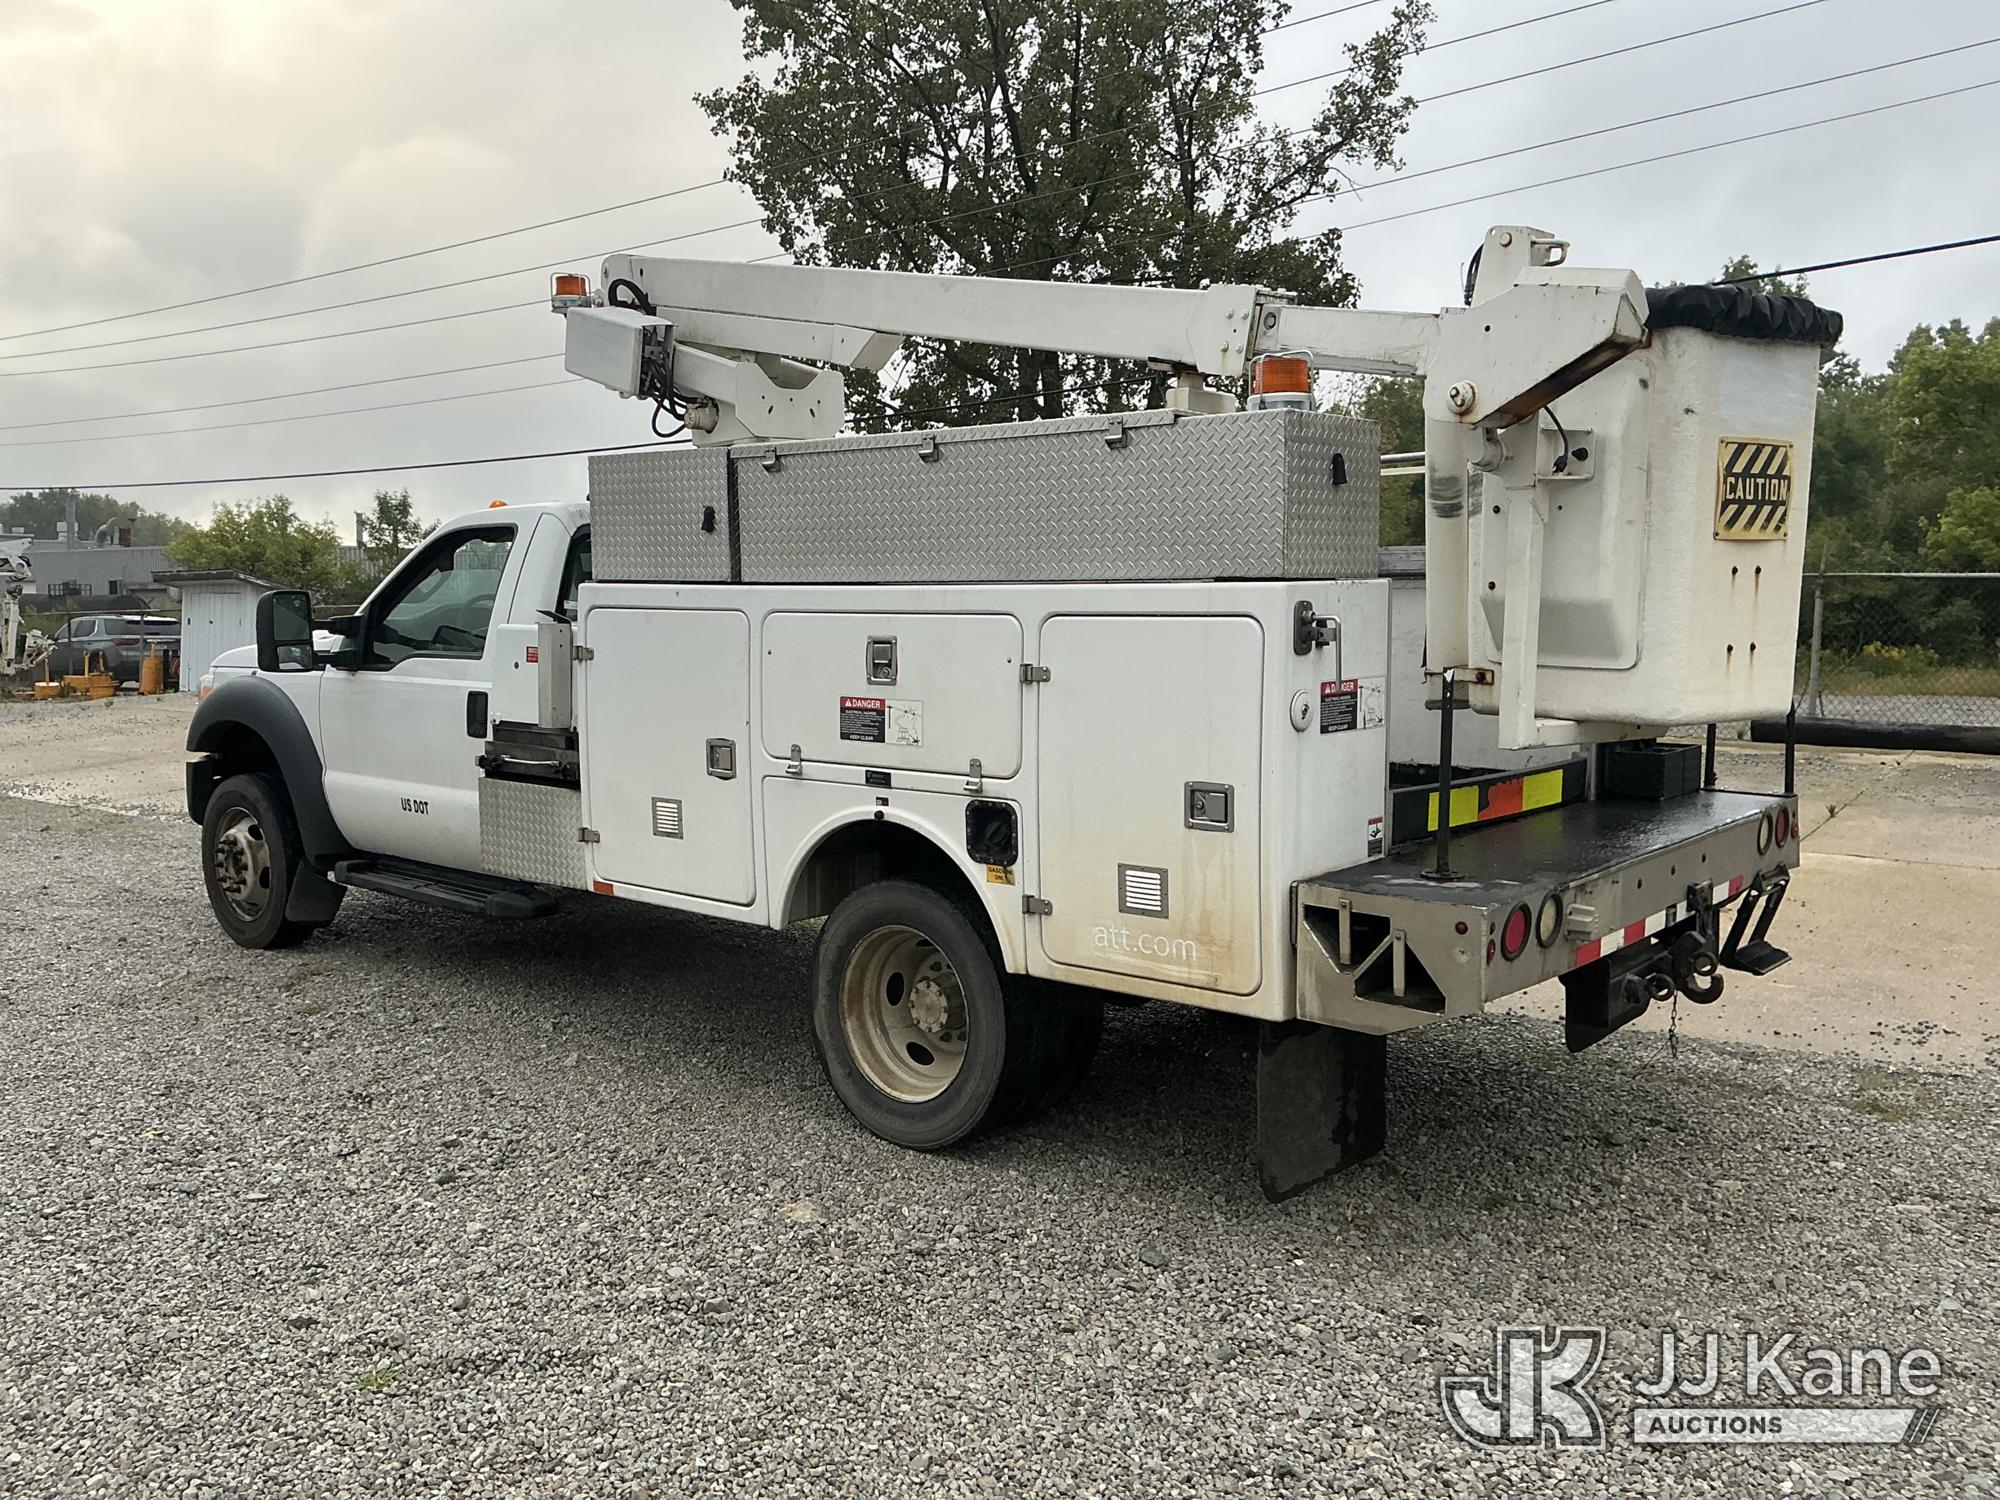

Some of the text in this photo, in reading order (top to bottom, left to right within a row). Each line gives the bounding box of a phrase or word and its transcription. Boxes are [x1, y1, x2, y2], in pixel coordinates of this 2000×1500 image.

[1726, 476, 1788, 501] CAUTION
[1331, 681, 1355, 693] DGER
[852, 699, 881, 709] DANGER
[400, 797, 429, 815] US DOT
[1094, 924, 1197, 961] att.com
